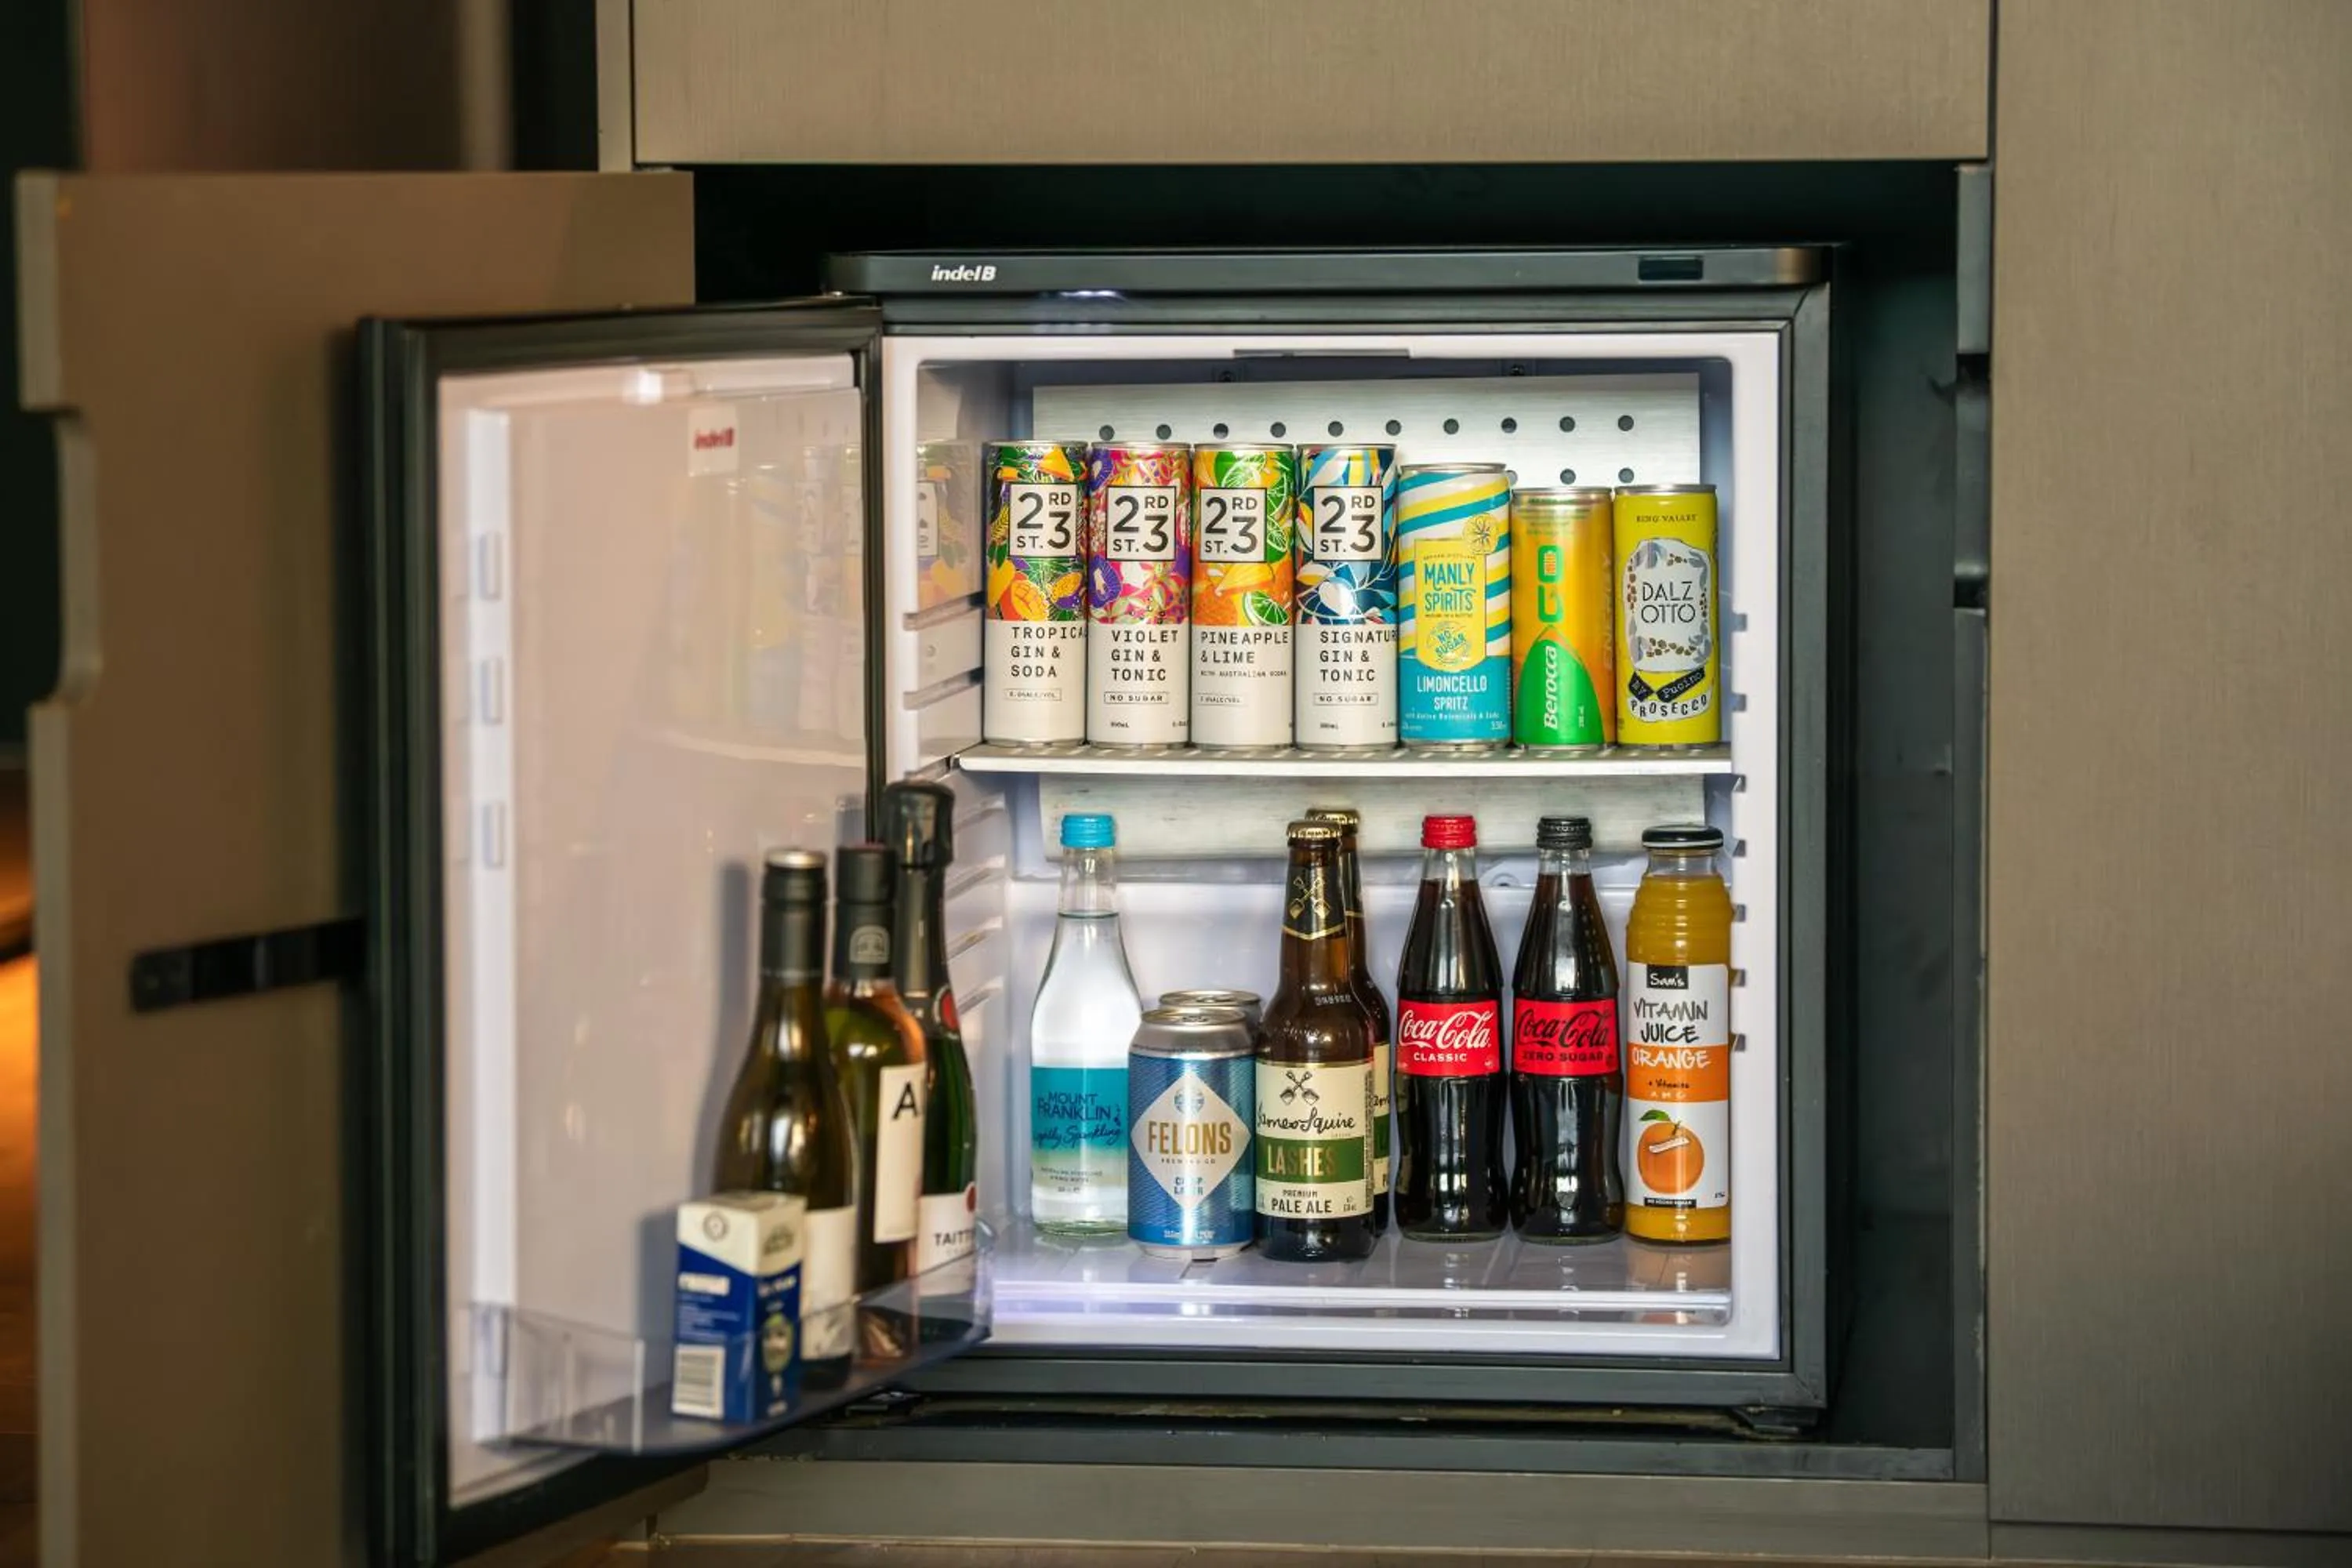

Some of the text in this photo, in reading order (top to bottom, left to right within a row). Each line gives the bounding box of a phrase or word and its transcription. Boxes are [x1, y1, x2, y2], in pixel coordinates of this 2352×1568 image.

[1017, 492, 1072, 529] 2 RD
[1112, 495, 1169, 532] 2 RD
[1204, 496, 1258, 535] 2 RD
[1319, 495, 1375, 534] 2 RD
[1017, 510, 1072, 550] ST. 3
[1112, 514, 1169, 553] ST. 3
[1204, 516, 1258, 554] ST. 3
[1319, 514, 1376, 554] ST. 3
[1424, 562, 1475, 590] MANLY
[1424, 588, 1476, 612] SPIRITS
[1642, 581, 1693, 601] DALZ
[1641, 603, 1696, 623] OTTO
[1111, 630, 1178, 643] VIOLET
[1200, 631, 1289, 644] PINEAPPLE
[1011, 645, 1061, 659] GIN &
[1111, 648, 1161, 662] GIN &
[1200, 650, 1255, 664] & LIME
[1319, 650, 1370, 662] GIN &
[1011, 665, 1058, 677] SODA
[1111, 669, 1166, 681] TONIC
[1319, 669, 1376, 681] TONIC
[1417, 675, 1487, 693] LIMONCELLO
[1543, 644, 1559, 729] Berocca
[1433, 695, 1468, 710] SPRITZ
[1631, 694, 1707, 717] PROSECCO
[1650, 972, 1686, 986] Sam's
[1633, 997, 1708, 1021] VITAMIN
[1640, 1022, 1700, 1044] JUICE
[1414, 1051, 1467, 1063] CLASSIC
[1522, 1051, 1603, 1063] ZERO SUGAR
[1632, 1047, 1711, 1070] ORANGE
[891, 1081, 918, 1121] A
[1037, 1097, 1111, 1121] FRANKLIN
[1048, 1091, 1098, 1105] MOUNT
[1299, 1107, 1356, 1134] Squire
[1147, 1120, 1232, 1156] FELONS
[1271, 1198, 1301, 1212] PALE
[1305, 1200, 1332, 1213] ALE
